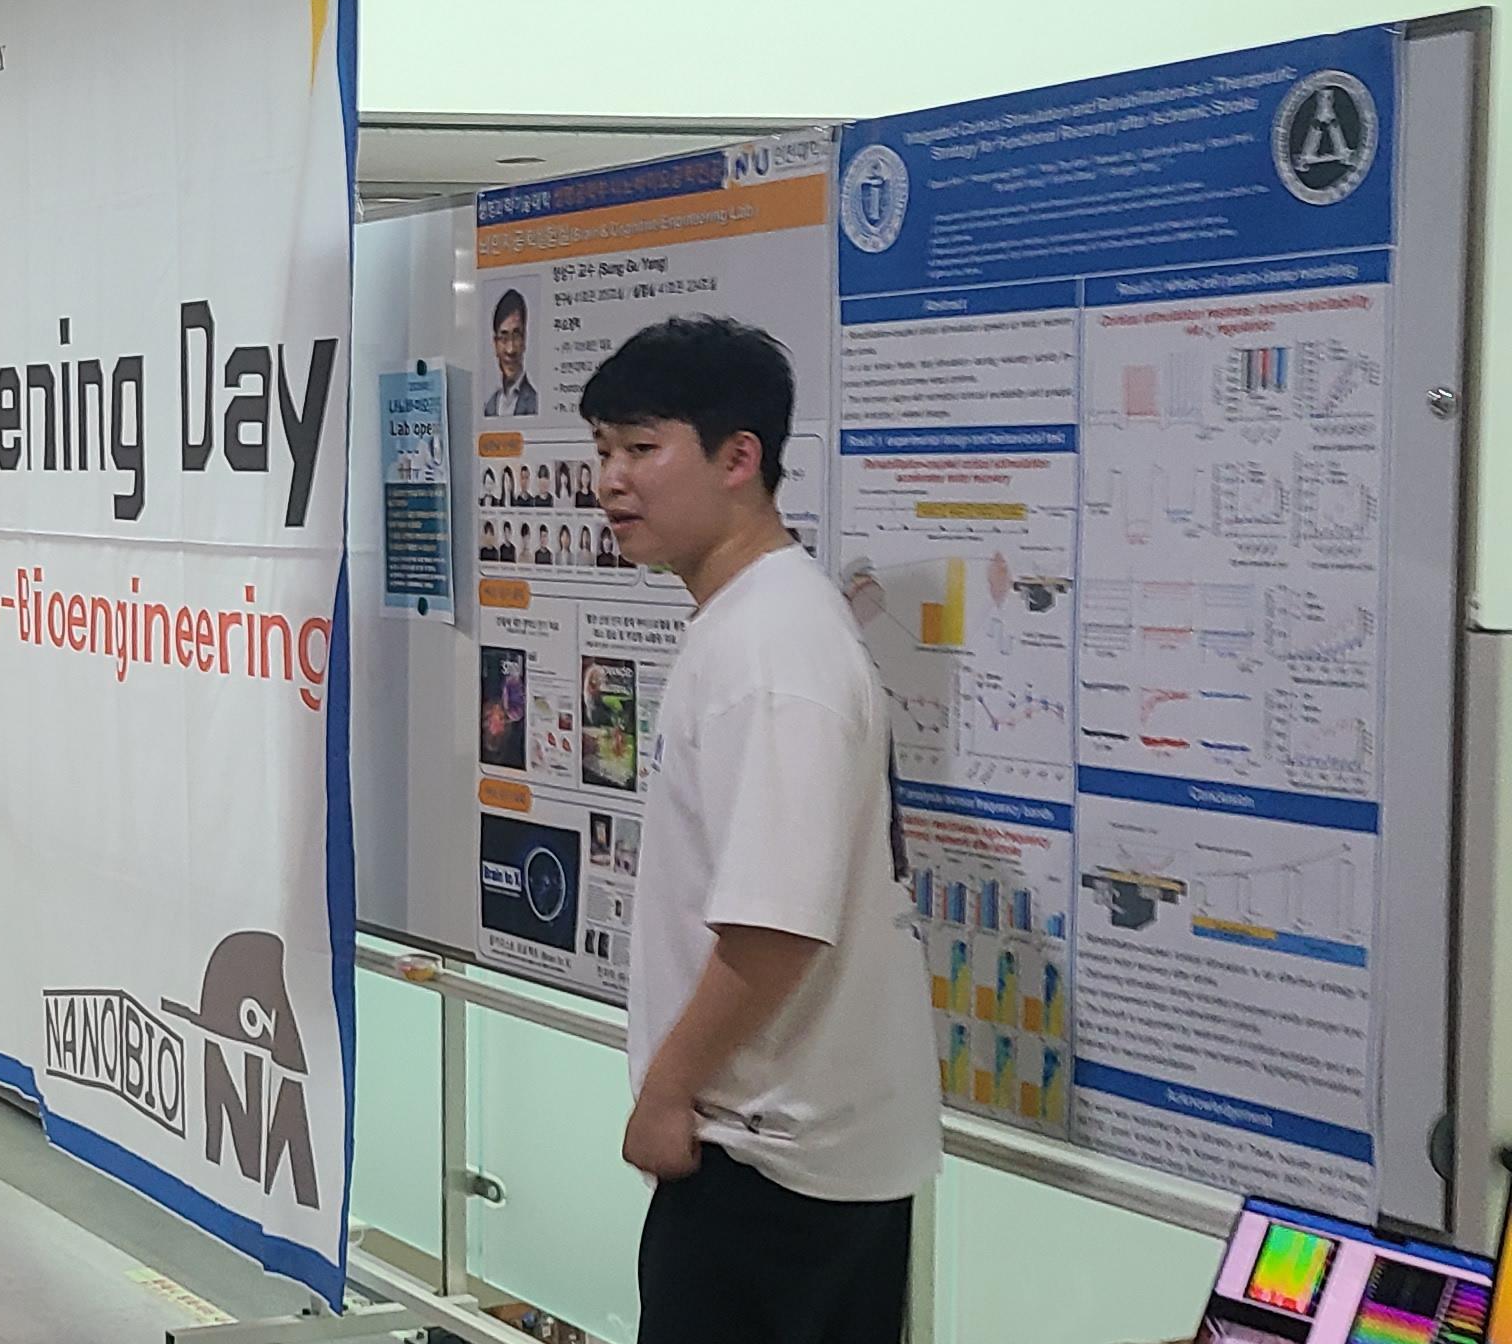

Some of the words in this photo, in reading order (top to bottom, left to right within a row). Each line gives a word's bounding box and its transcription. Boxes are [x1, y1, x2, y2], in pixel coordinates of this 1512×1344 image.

[180, 299, 339, 528] Day
[389, 420, 410, 436] Lab
[45, 996, 180, 1123] NANOBIO
